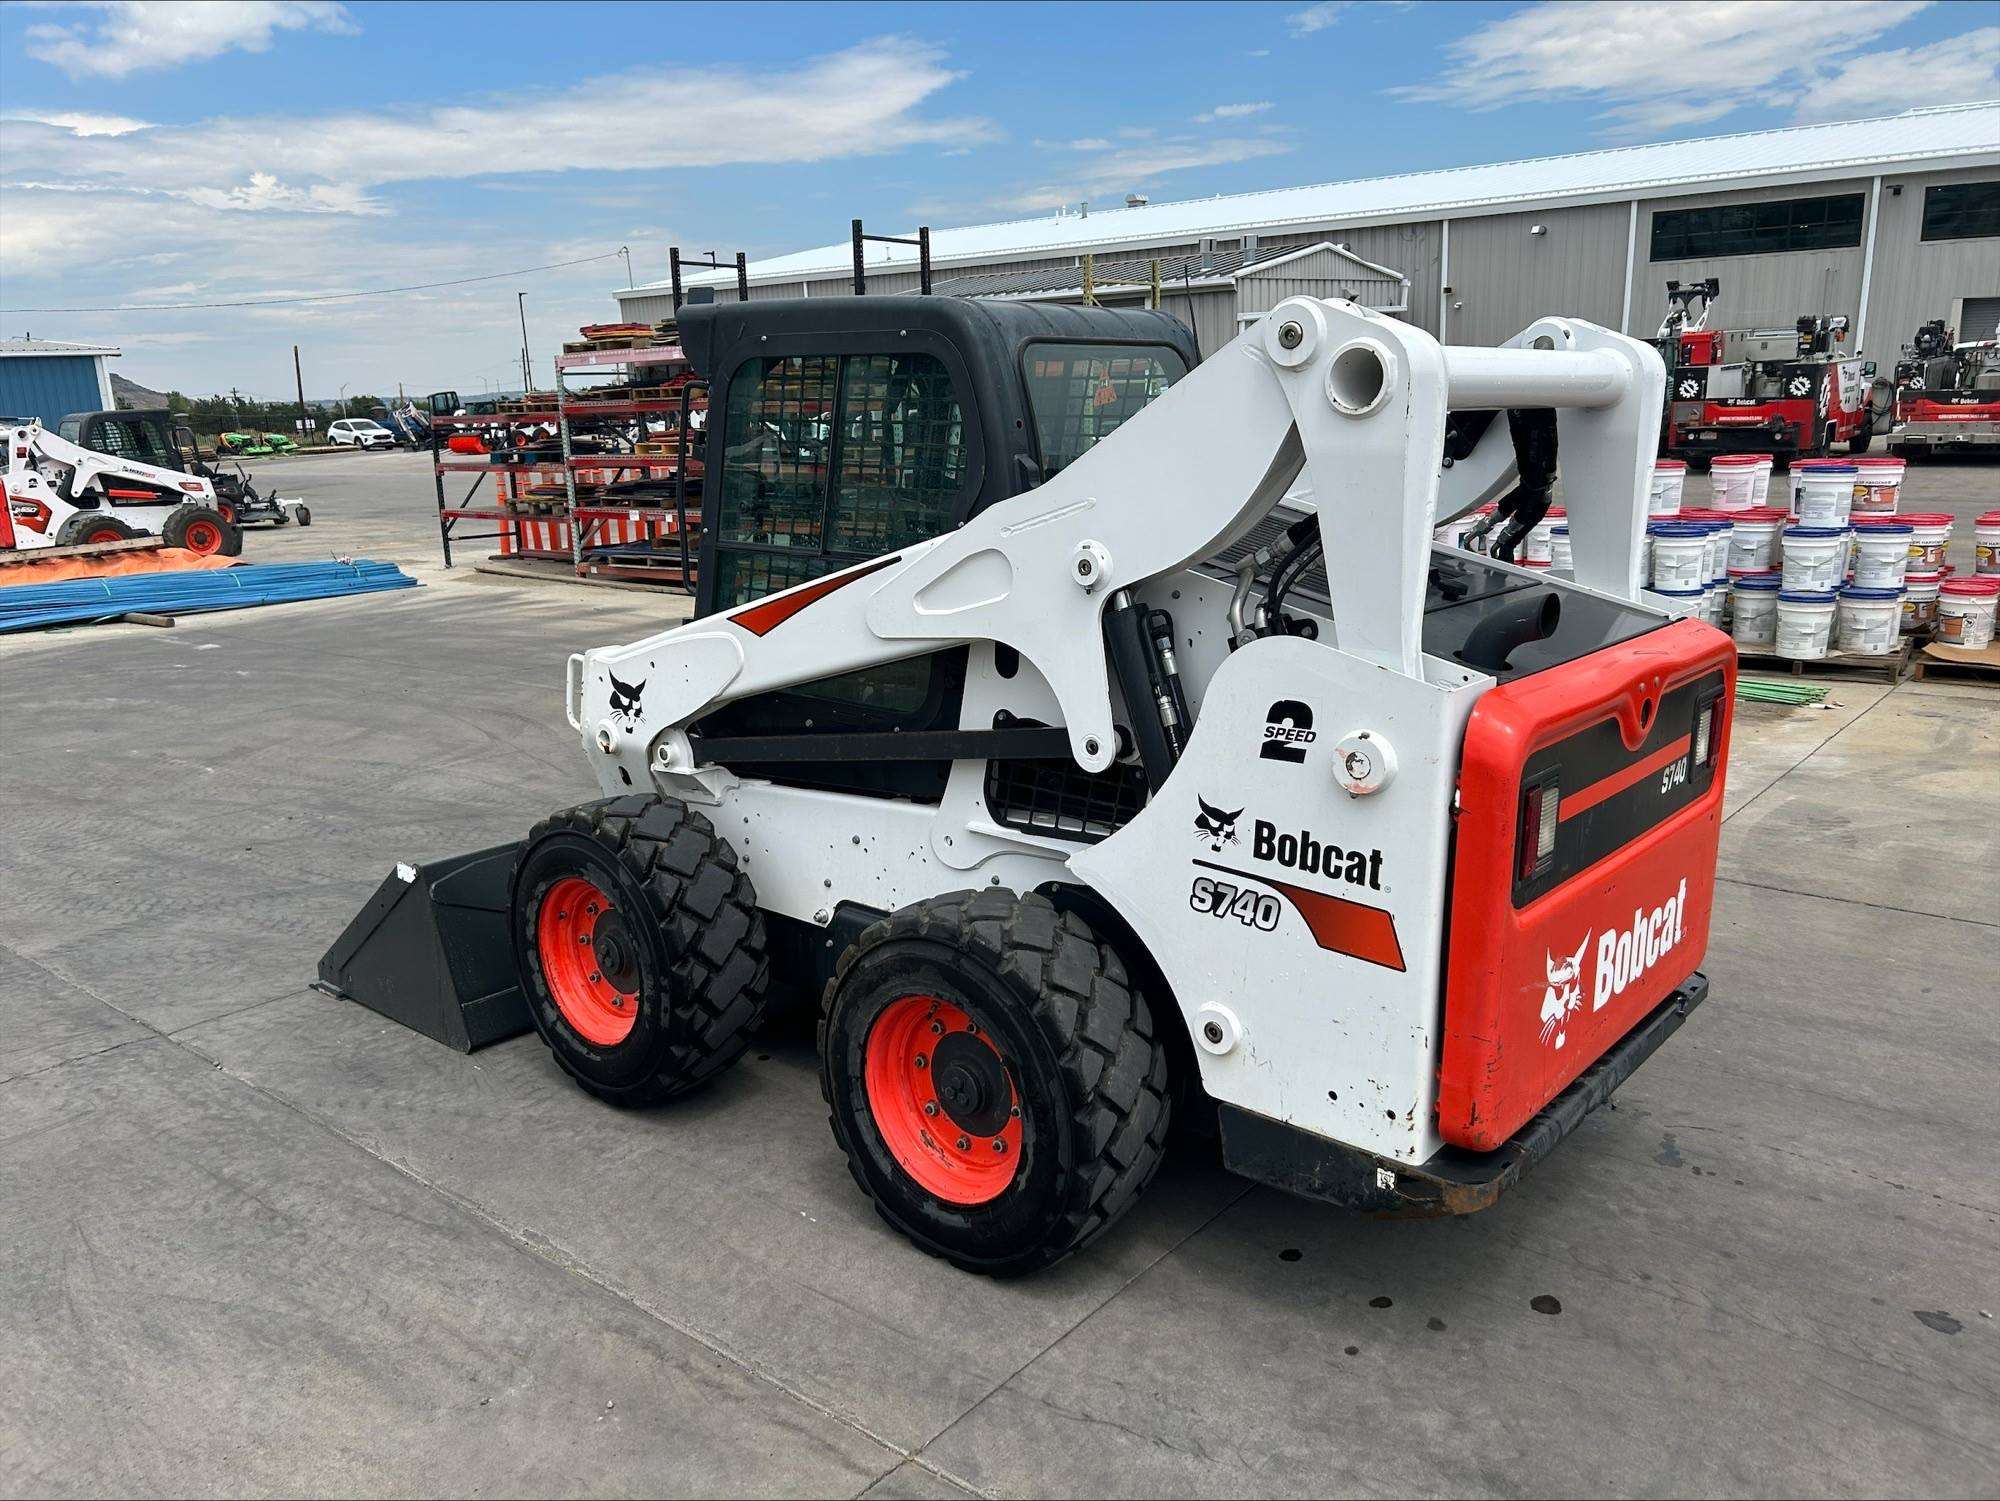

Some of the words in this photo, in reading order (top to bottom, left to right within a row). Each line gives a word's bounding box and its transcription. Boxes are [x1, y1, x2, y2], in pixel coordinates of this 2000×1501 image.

[1260, 700, 1313, 763] 2
[1264, 726, 1316, 742] SPEED
[1661, 756, 1687, 794] S740
[1253, 819, 1383, 890] Bobcat
[1190, 877, 1281, 931] S740
[1593, 877, 1687, 1012] Bobcat
